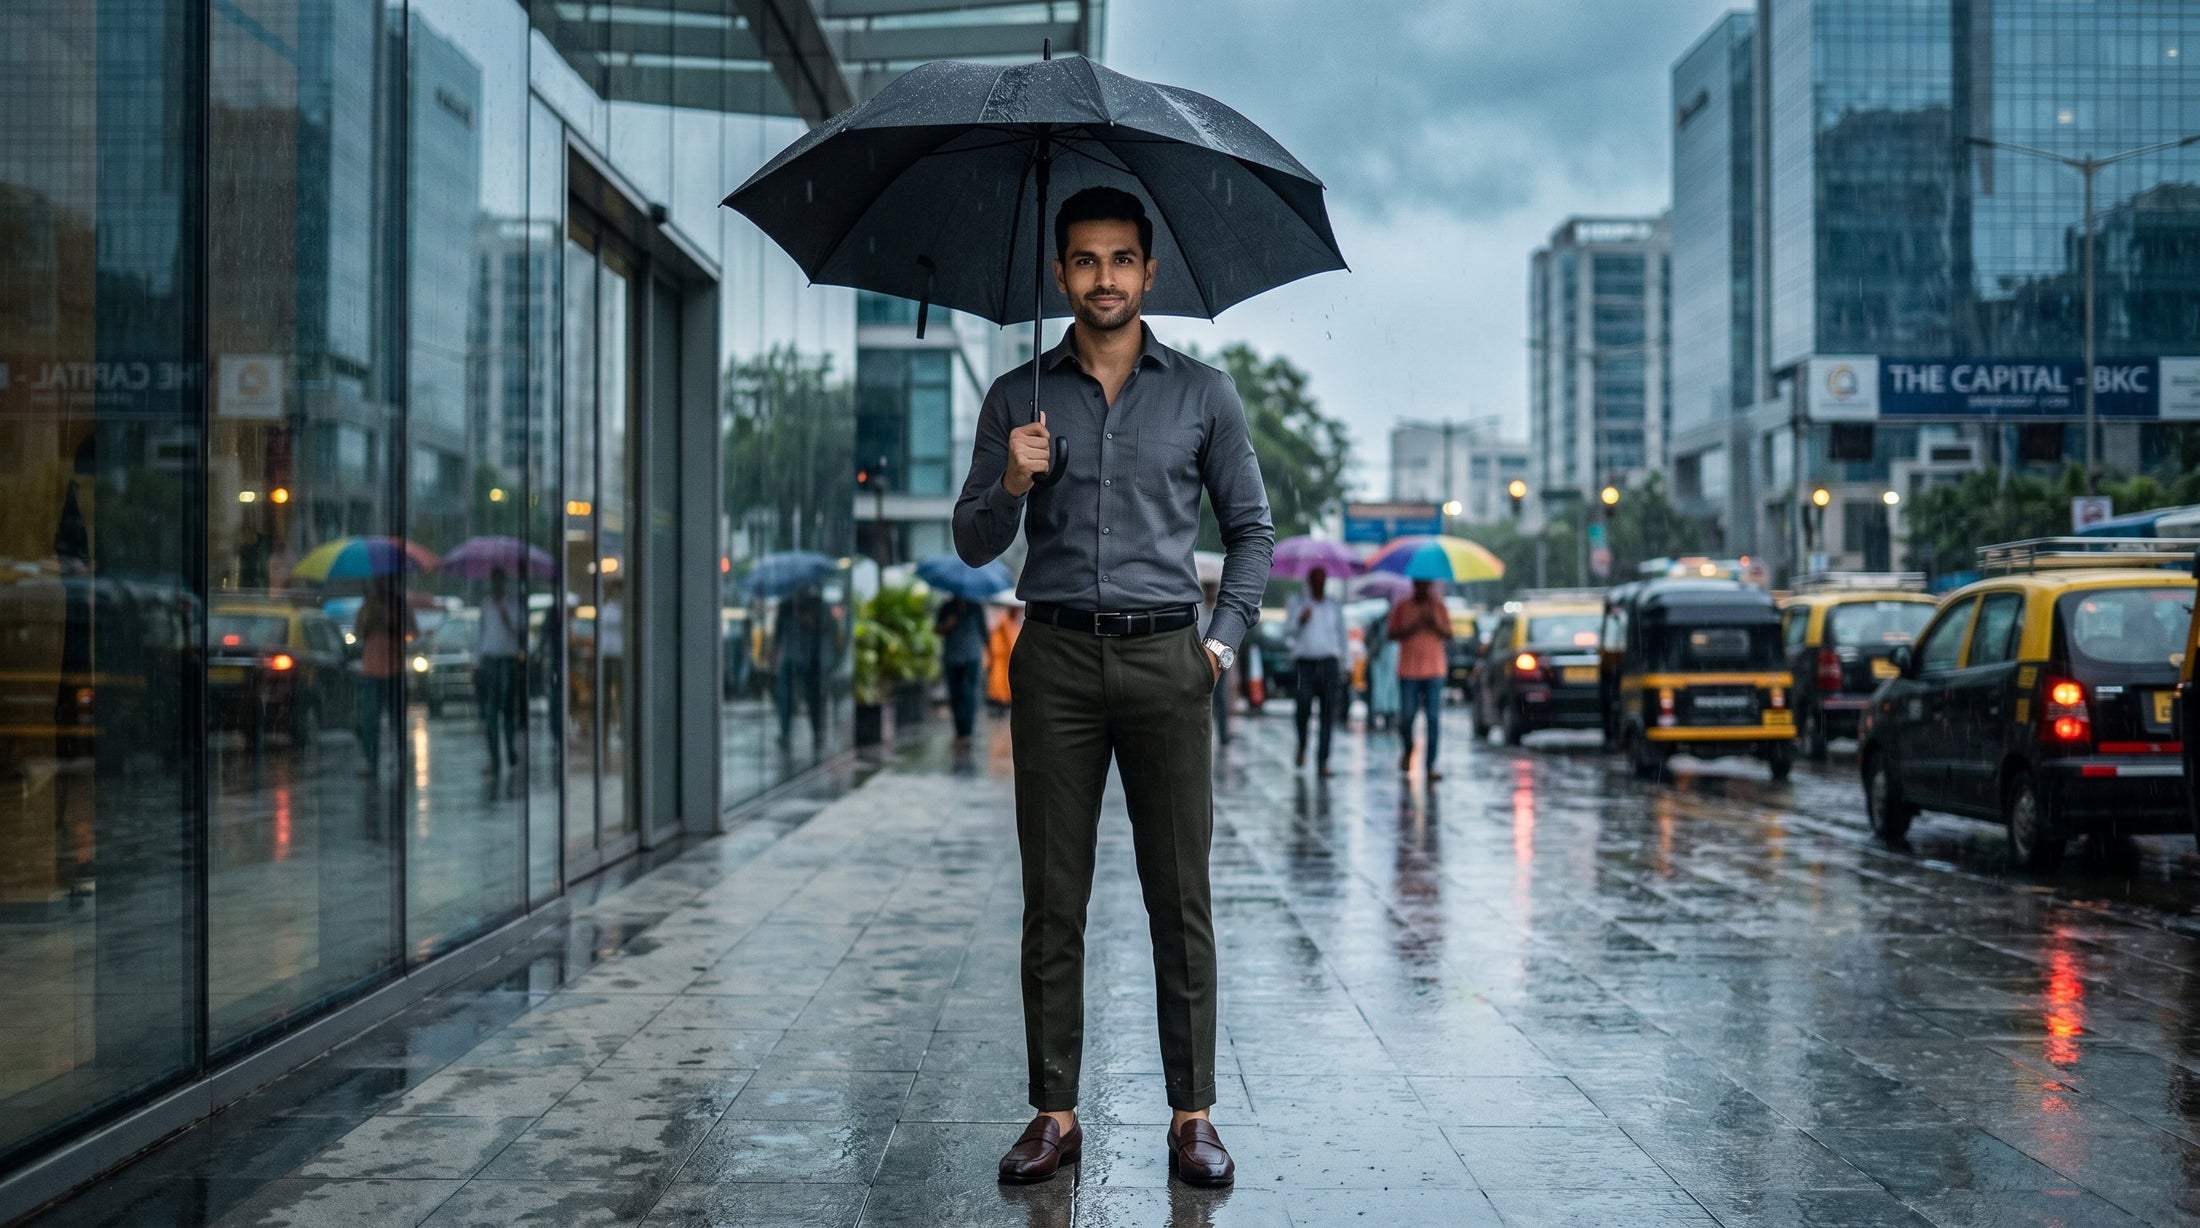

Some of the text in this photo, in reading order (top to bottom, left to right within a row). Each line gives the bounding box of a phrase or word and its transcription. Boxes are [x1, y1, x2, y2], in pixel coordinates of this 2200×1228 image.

[1888, 365, 1945, 393] THE
[1951, 365, 2070, 393] CAPITAL
[2093, 365, 2149, 393] BKC
